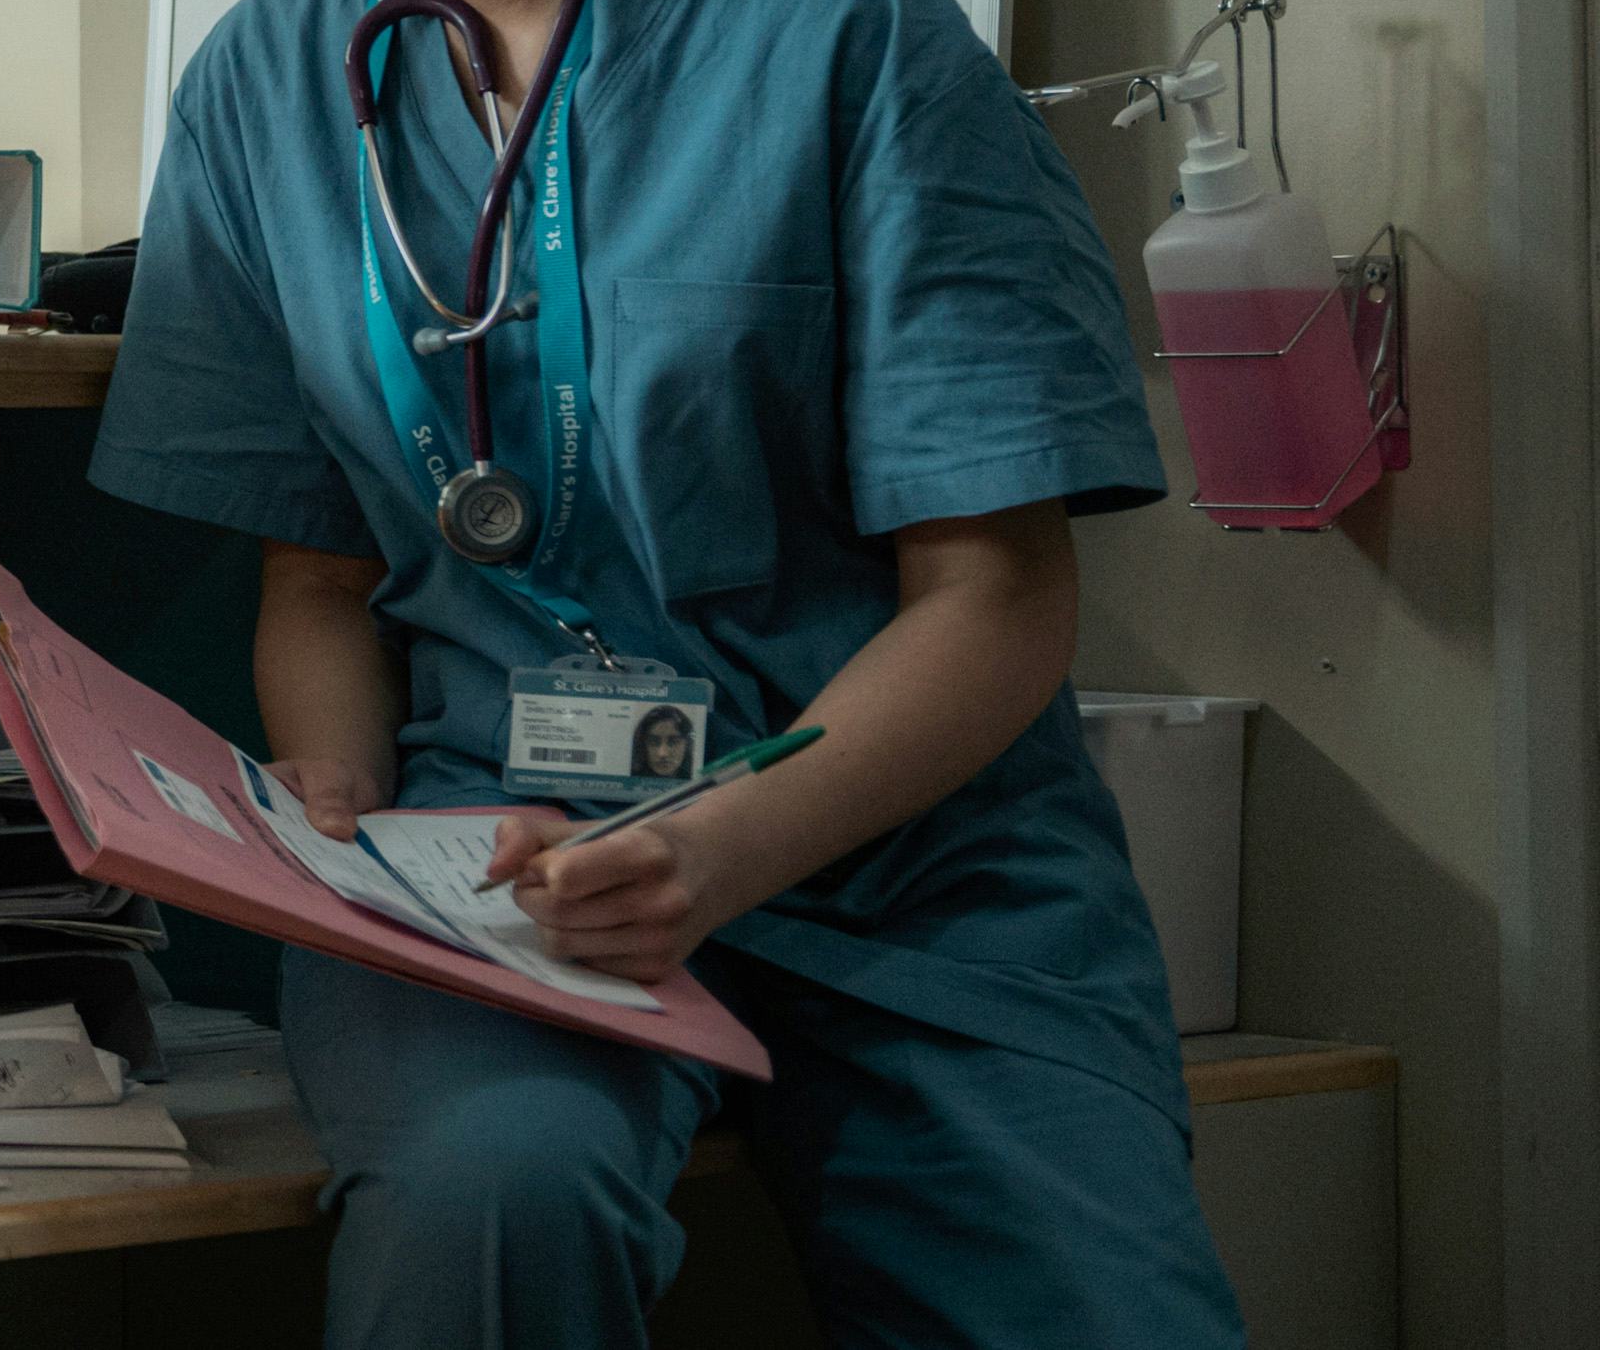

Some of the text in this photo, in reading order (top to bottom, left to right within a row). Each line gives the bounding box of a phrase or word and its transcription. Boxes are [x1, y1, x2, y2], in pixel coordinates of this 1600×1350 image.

[543, 66, 573, 251] St. Clare's Hospital
[412, 425, 448, 487] St. Cla
[554, 383, 582, 470] Hospital
[552, 475, 577, 537] Clare's
[553, 679, 669, 698] St. Clare's Hospital
